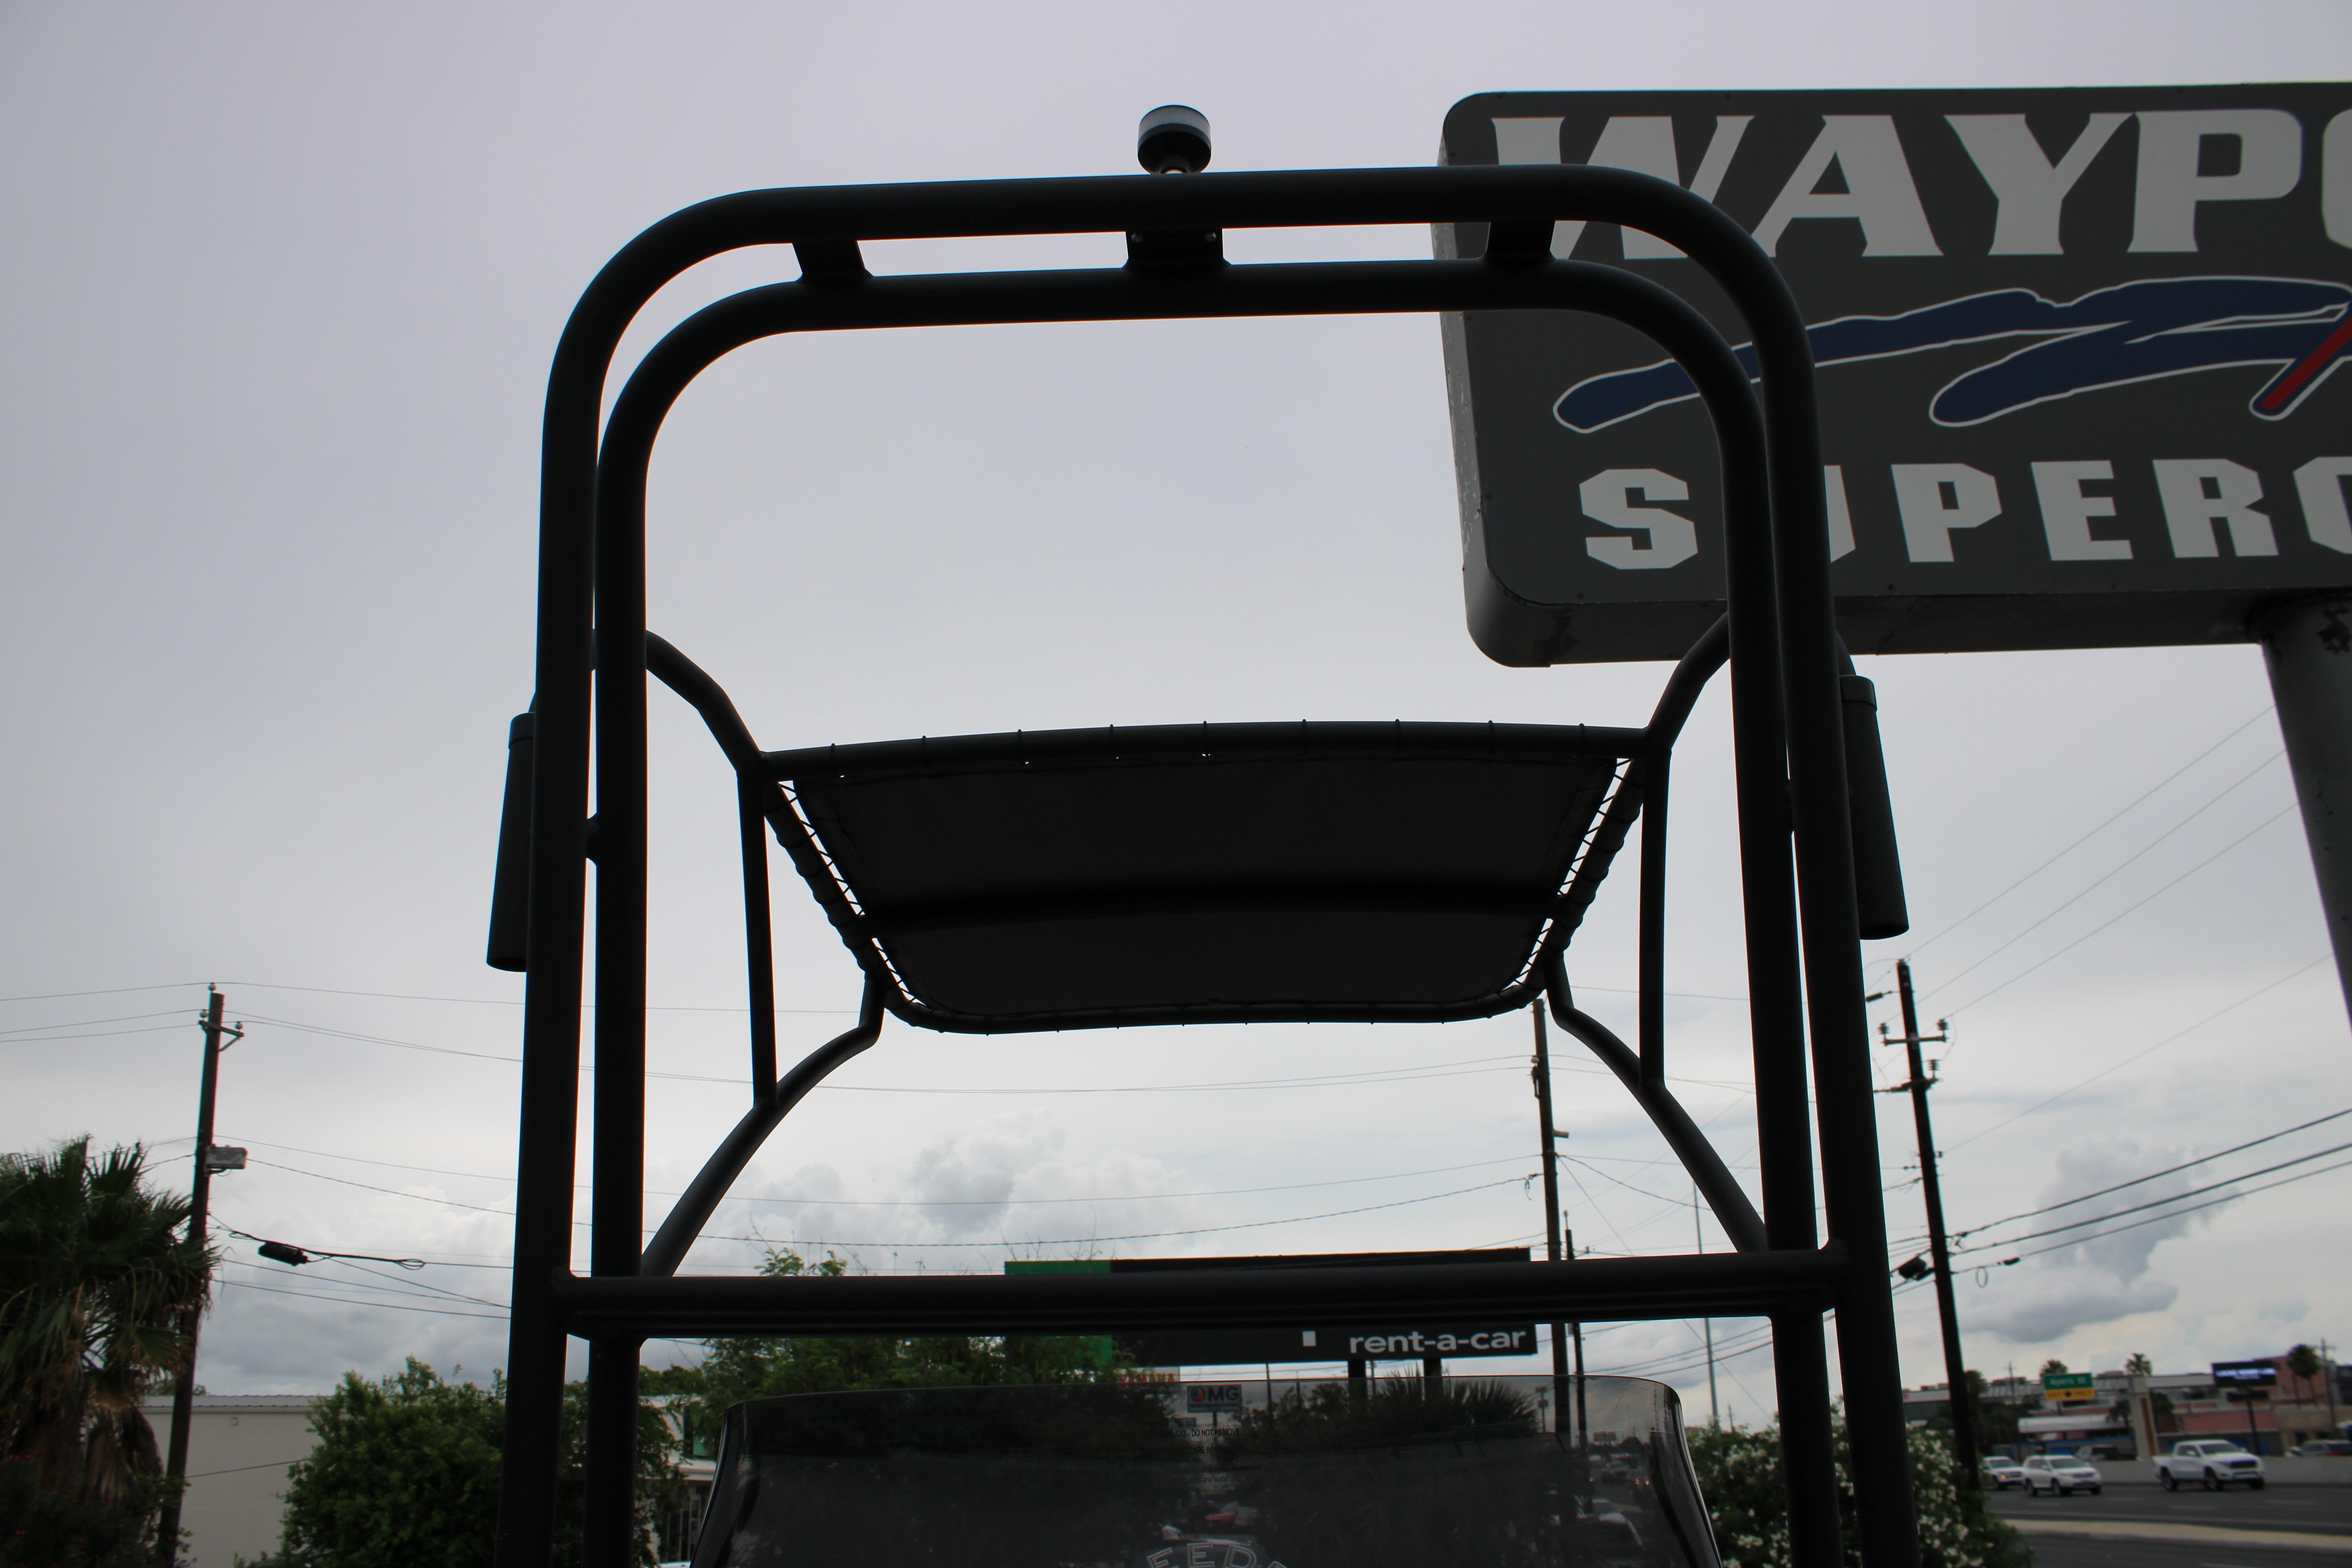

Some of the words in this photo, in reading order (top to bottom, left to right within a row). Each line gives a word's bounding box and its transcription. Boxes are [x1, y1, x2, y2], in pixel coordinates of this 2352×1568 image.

[1491, 108, 2352, 260] WAYP
[1579, 456, 2352, 570] SPER
[1349, 1331, 1526, 1354] rent-a-car
[1215, 1428, 1240, 1436] REMOVE
